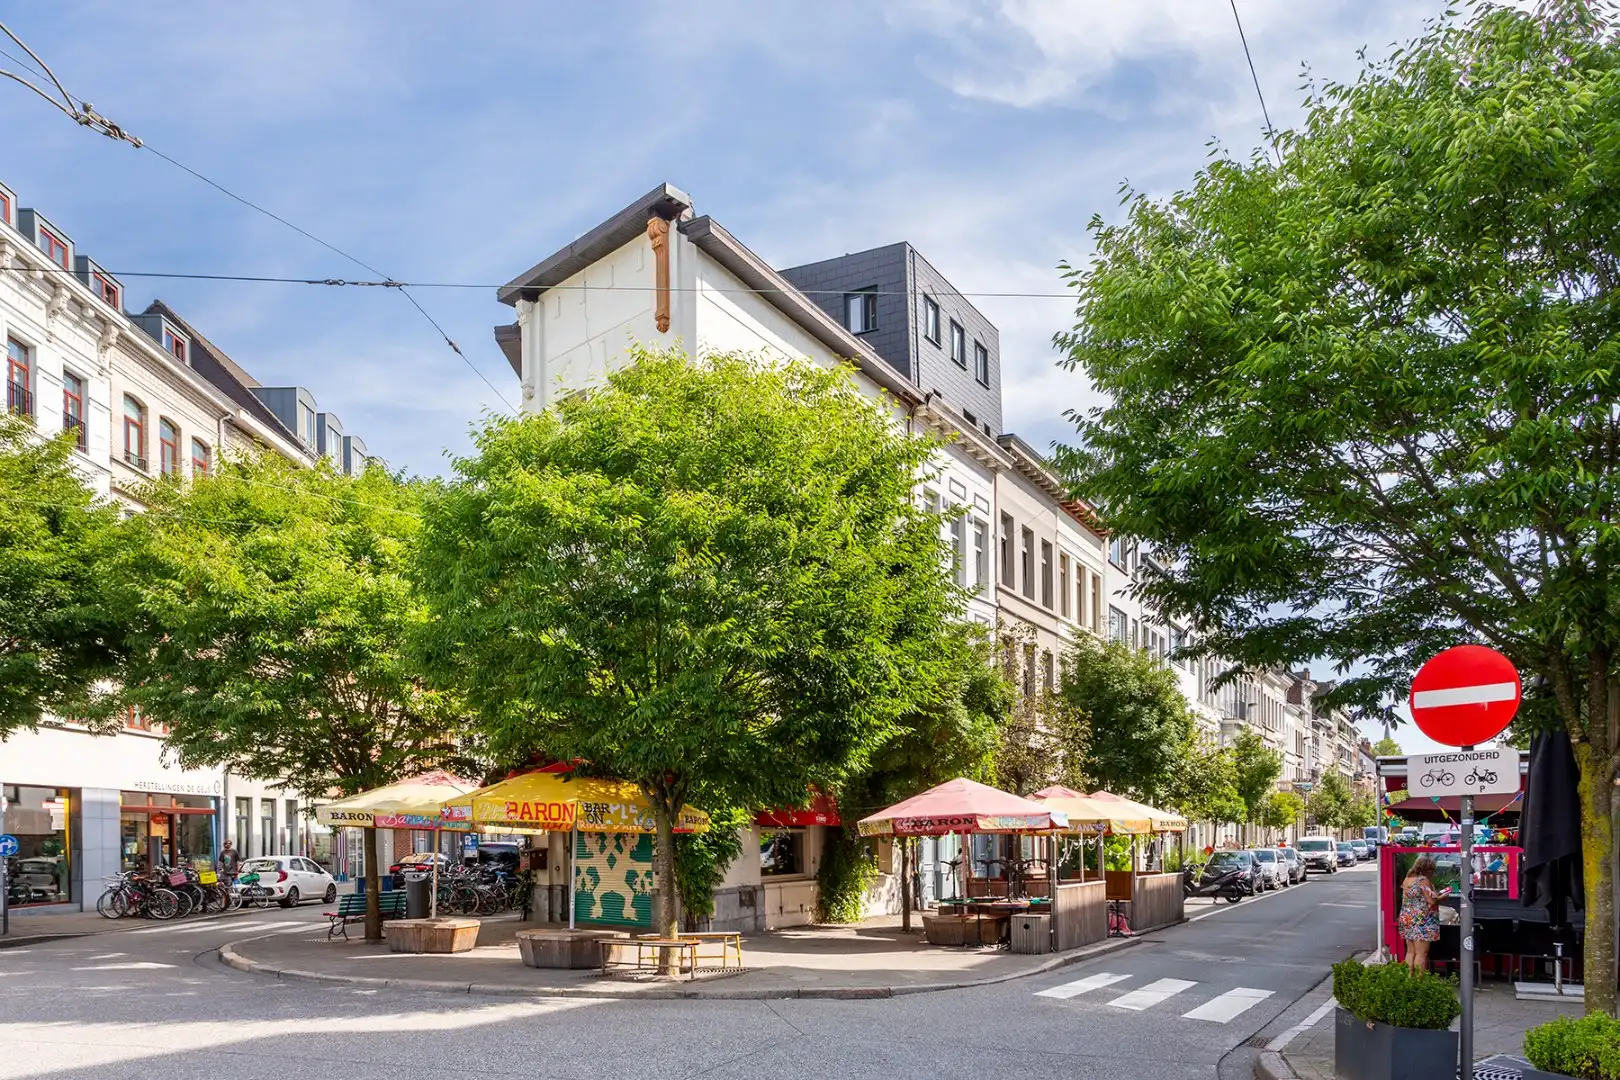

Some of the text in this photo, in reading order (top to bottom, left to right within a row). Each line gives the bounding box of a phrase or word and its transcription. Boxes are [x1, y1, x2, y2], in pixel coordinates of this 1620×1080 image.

[1424, 751, 1500, 764] UITGEZONDERD
[1480, 785, 1486, 793] P
[330, 811, 373, 821] BARON
[505, 801, 576, 821] BARON
[1160, 820, 1186, 828] BARON
